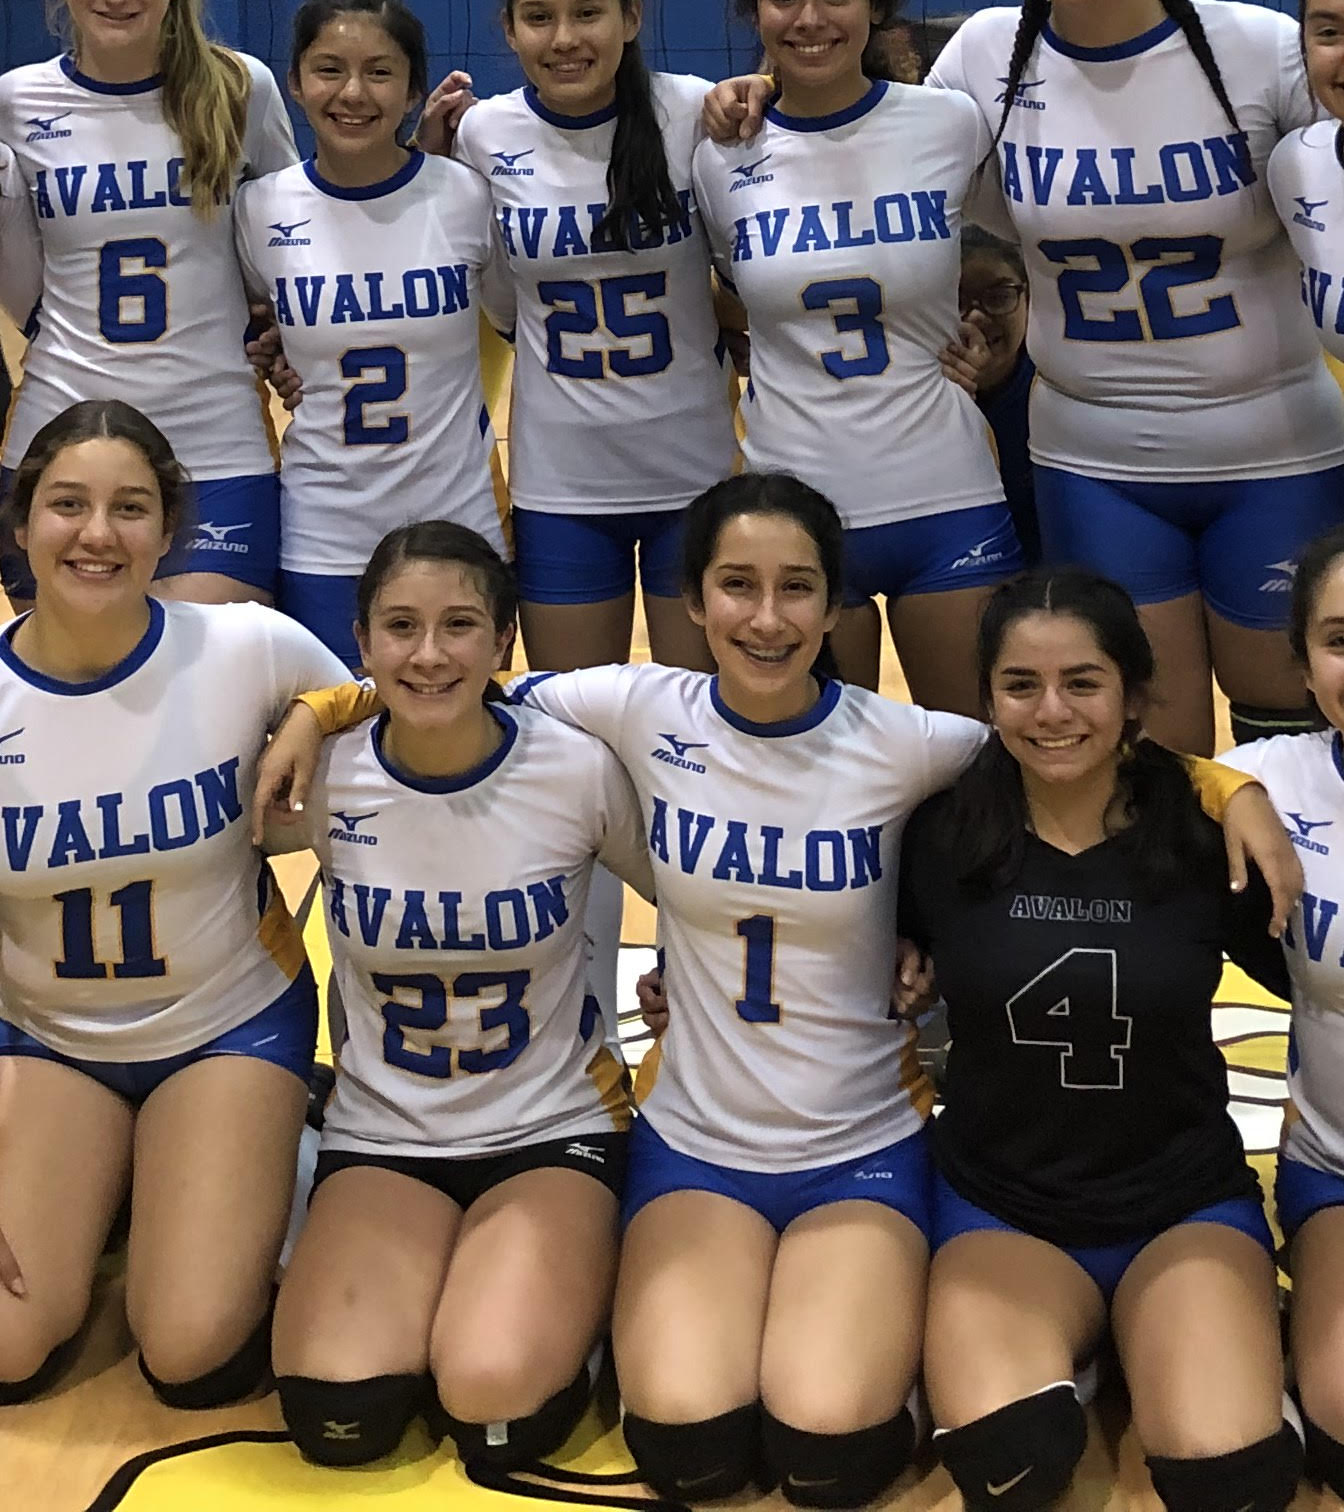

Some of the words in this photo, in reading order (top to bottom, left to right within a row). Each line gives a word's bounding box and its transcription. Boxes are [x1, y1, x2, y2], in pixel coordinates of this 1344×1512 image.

[1003, 131, 1258, 205] AVALON
[733, 190, 950, 262] AVALON
[99, 238, 167, 344] 6
[275, 263, 469, 326] AVALON
[537, 271, 673, 379] 25
[801, 277, 890, 379] 3
[1038, 235, 1241, 341] 22
[340, 346, 409, 445] 2
[650, 796, 882, 892] AVALON
[53, 879, 167, 980] 11
[331, 874, 570, 951] AVALON
[1009, 894, 1131, 923] AVALON
[735, 914, 781, 1024] 1
[1006, 948, 1133, 1089] 4
[371, 969, 533, 1078] 23
